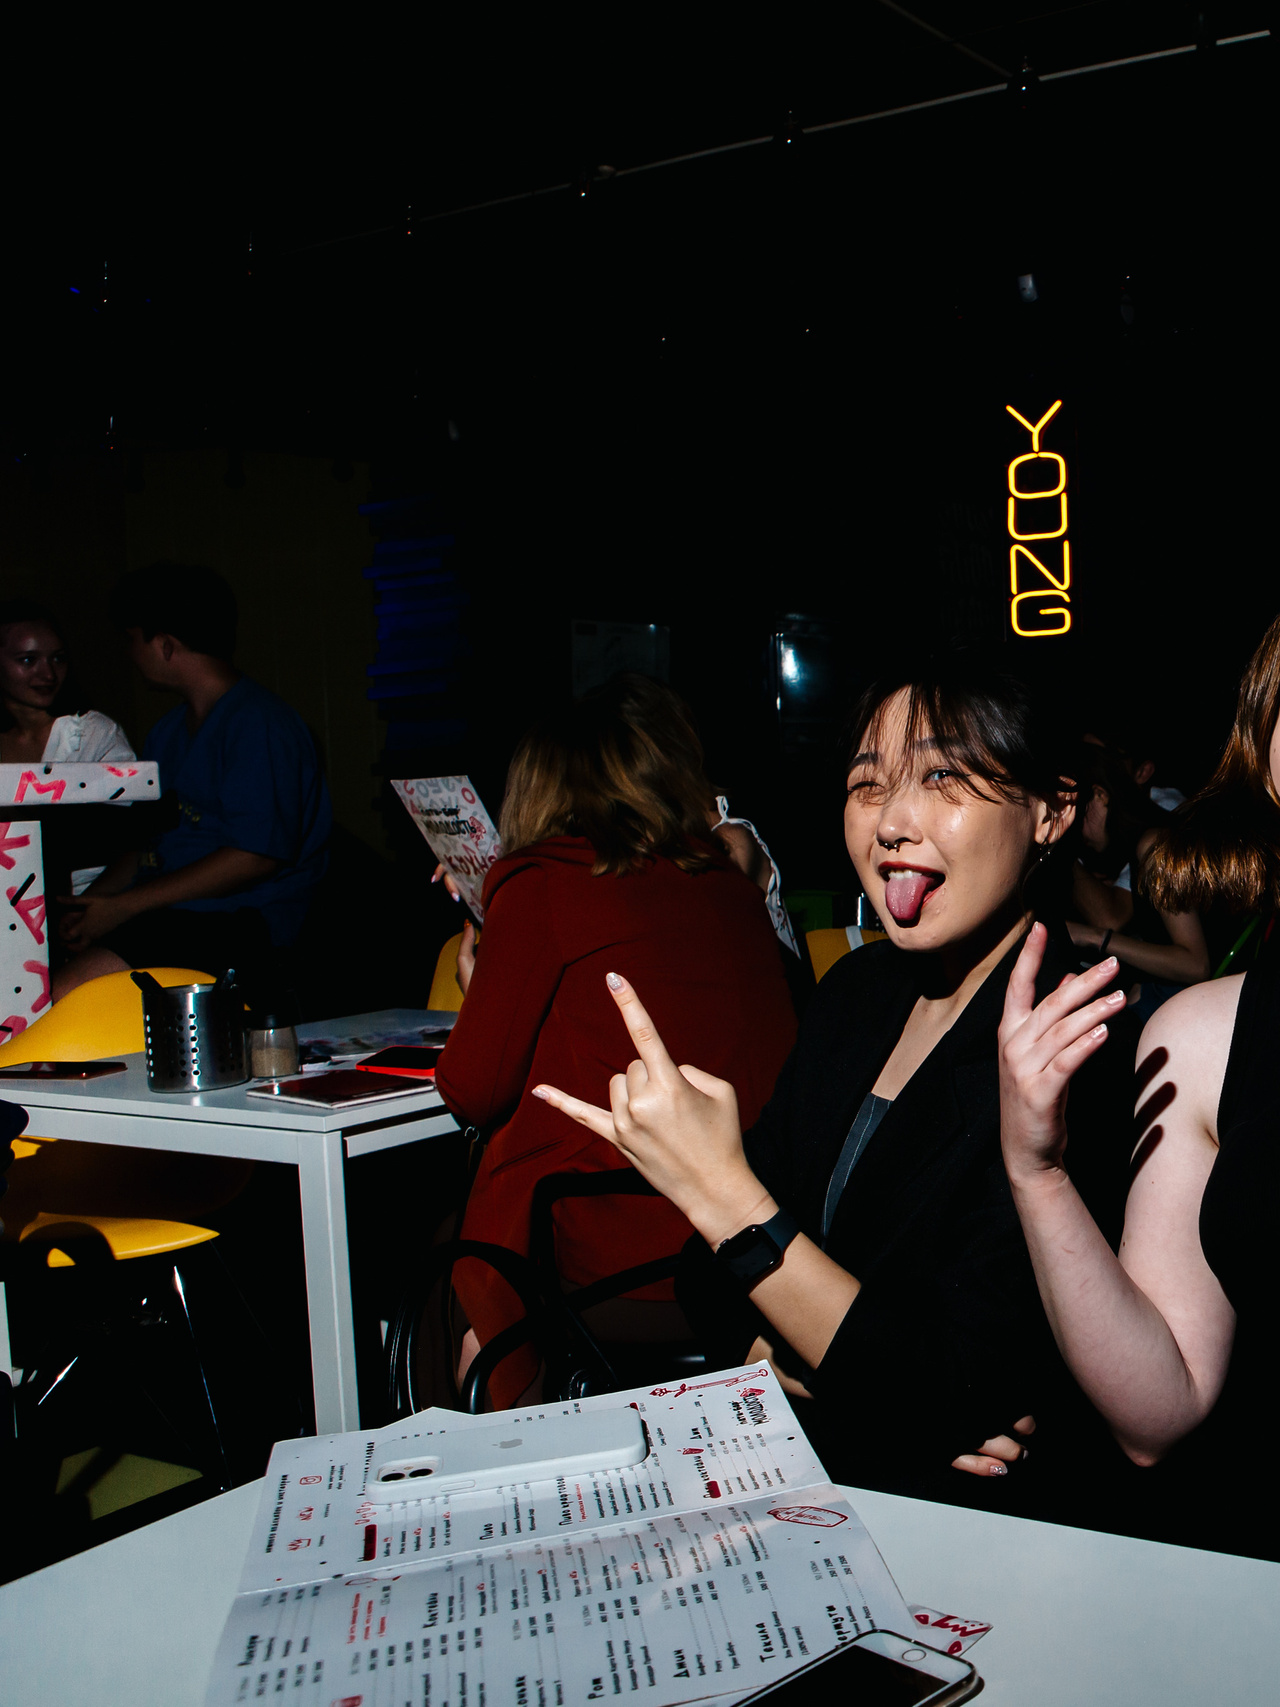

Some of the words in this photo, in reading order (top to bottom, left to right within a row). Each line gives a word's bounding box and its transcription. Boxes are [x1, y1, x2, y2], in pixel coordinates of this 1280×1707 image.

[1005, 399, 1073, 638] YOUNG
[740, 1390, 769, 1426] МОЛОДОСТЬ
[694, 1456, 710, 1481] коктейли
[558, 1510, 572, 1526] Пиво
[479, 1523, 494, 1540] Пиво
[823, 1558, 833, 1567] 2500
[838, 1555, 848, 1564] 2500
[756, 1571, 765, 1580] 5000
[829, 1570, 838, 1578] 250
[760, 1583, 769, 1591] 500
[422, 1592, 438, 1628] Коктейли
[756, 1622, 776, 1663] Текила
[673, 1649, 690, 1678] Джин
[516, 1676, 528, 1707] оньяк
[588, 1677, 604, 1700] Ром
